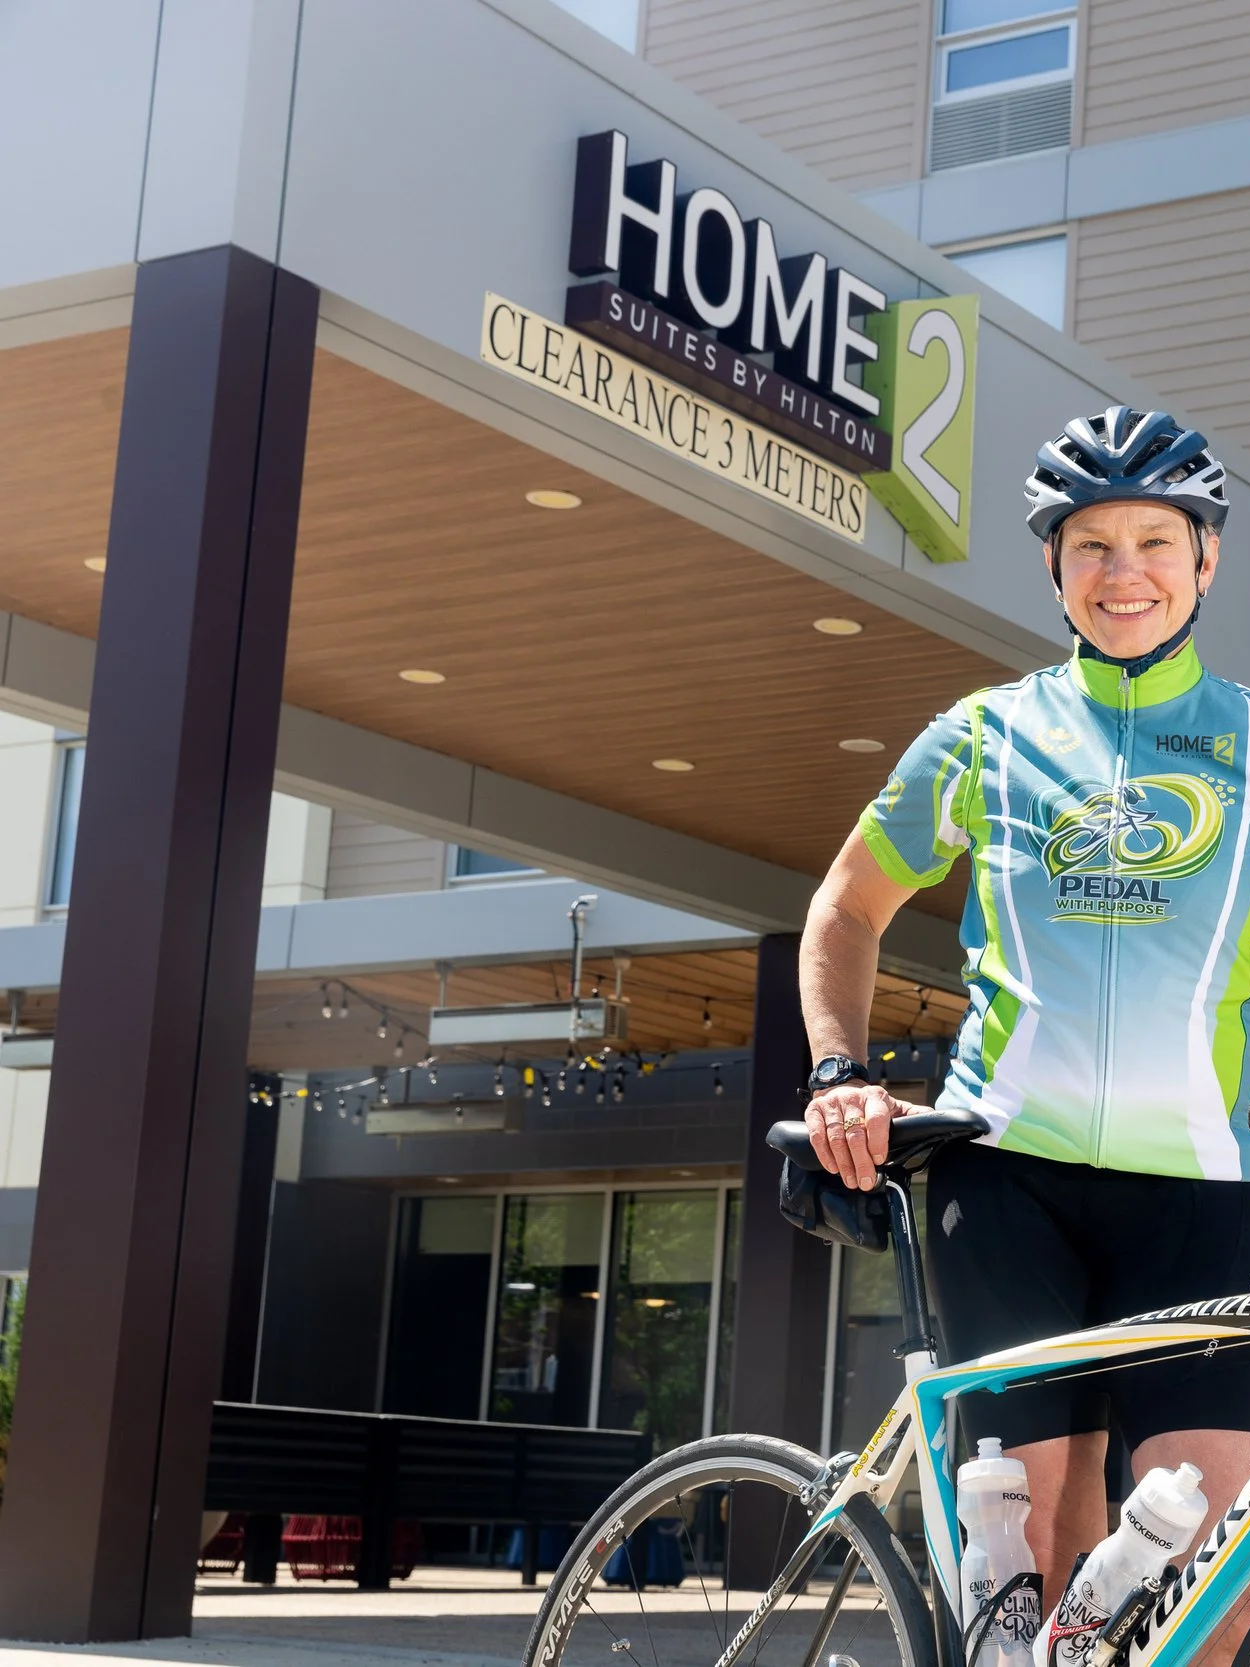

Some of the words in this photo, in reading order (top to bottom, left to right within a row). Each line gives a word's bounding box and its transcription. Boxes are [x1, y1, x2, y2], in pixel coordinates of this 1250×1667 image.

[605, 129, 887, 416] HOME
[901, 309, 966, 527] 2
[608, 293, 717, 371] SUITES
[733, 358, 768, 396] BY
[781, 384, 875, 455] HILTON
[488, 303, 710, 460] CLEARANCE
[718, 418, 734, 469] 3
[743, 440, 863, 535] METERS
[1156, 735, 1213, 753] HOME
[1216, 735, 1233, 762] 2
[1055, 898, 1094, 912] WITH
[1097, 900, 1165, 916] PURPOSE
[1058, 874, 1171, 904] PEDAL
[596, 1518, 625, 1553] C24
[1125, 1509, 1174, 1550] ROCKBROS
[969, 1578, 996, 1593] ENJOY
[539, 1559, 593, 1667] RA-ACE
[1112, 1604, 1145, 1643] LEZYNE
